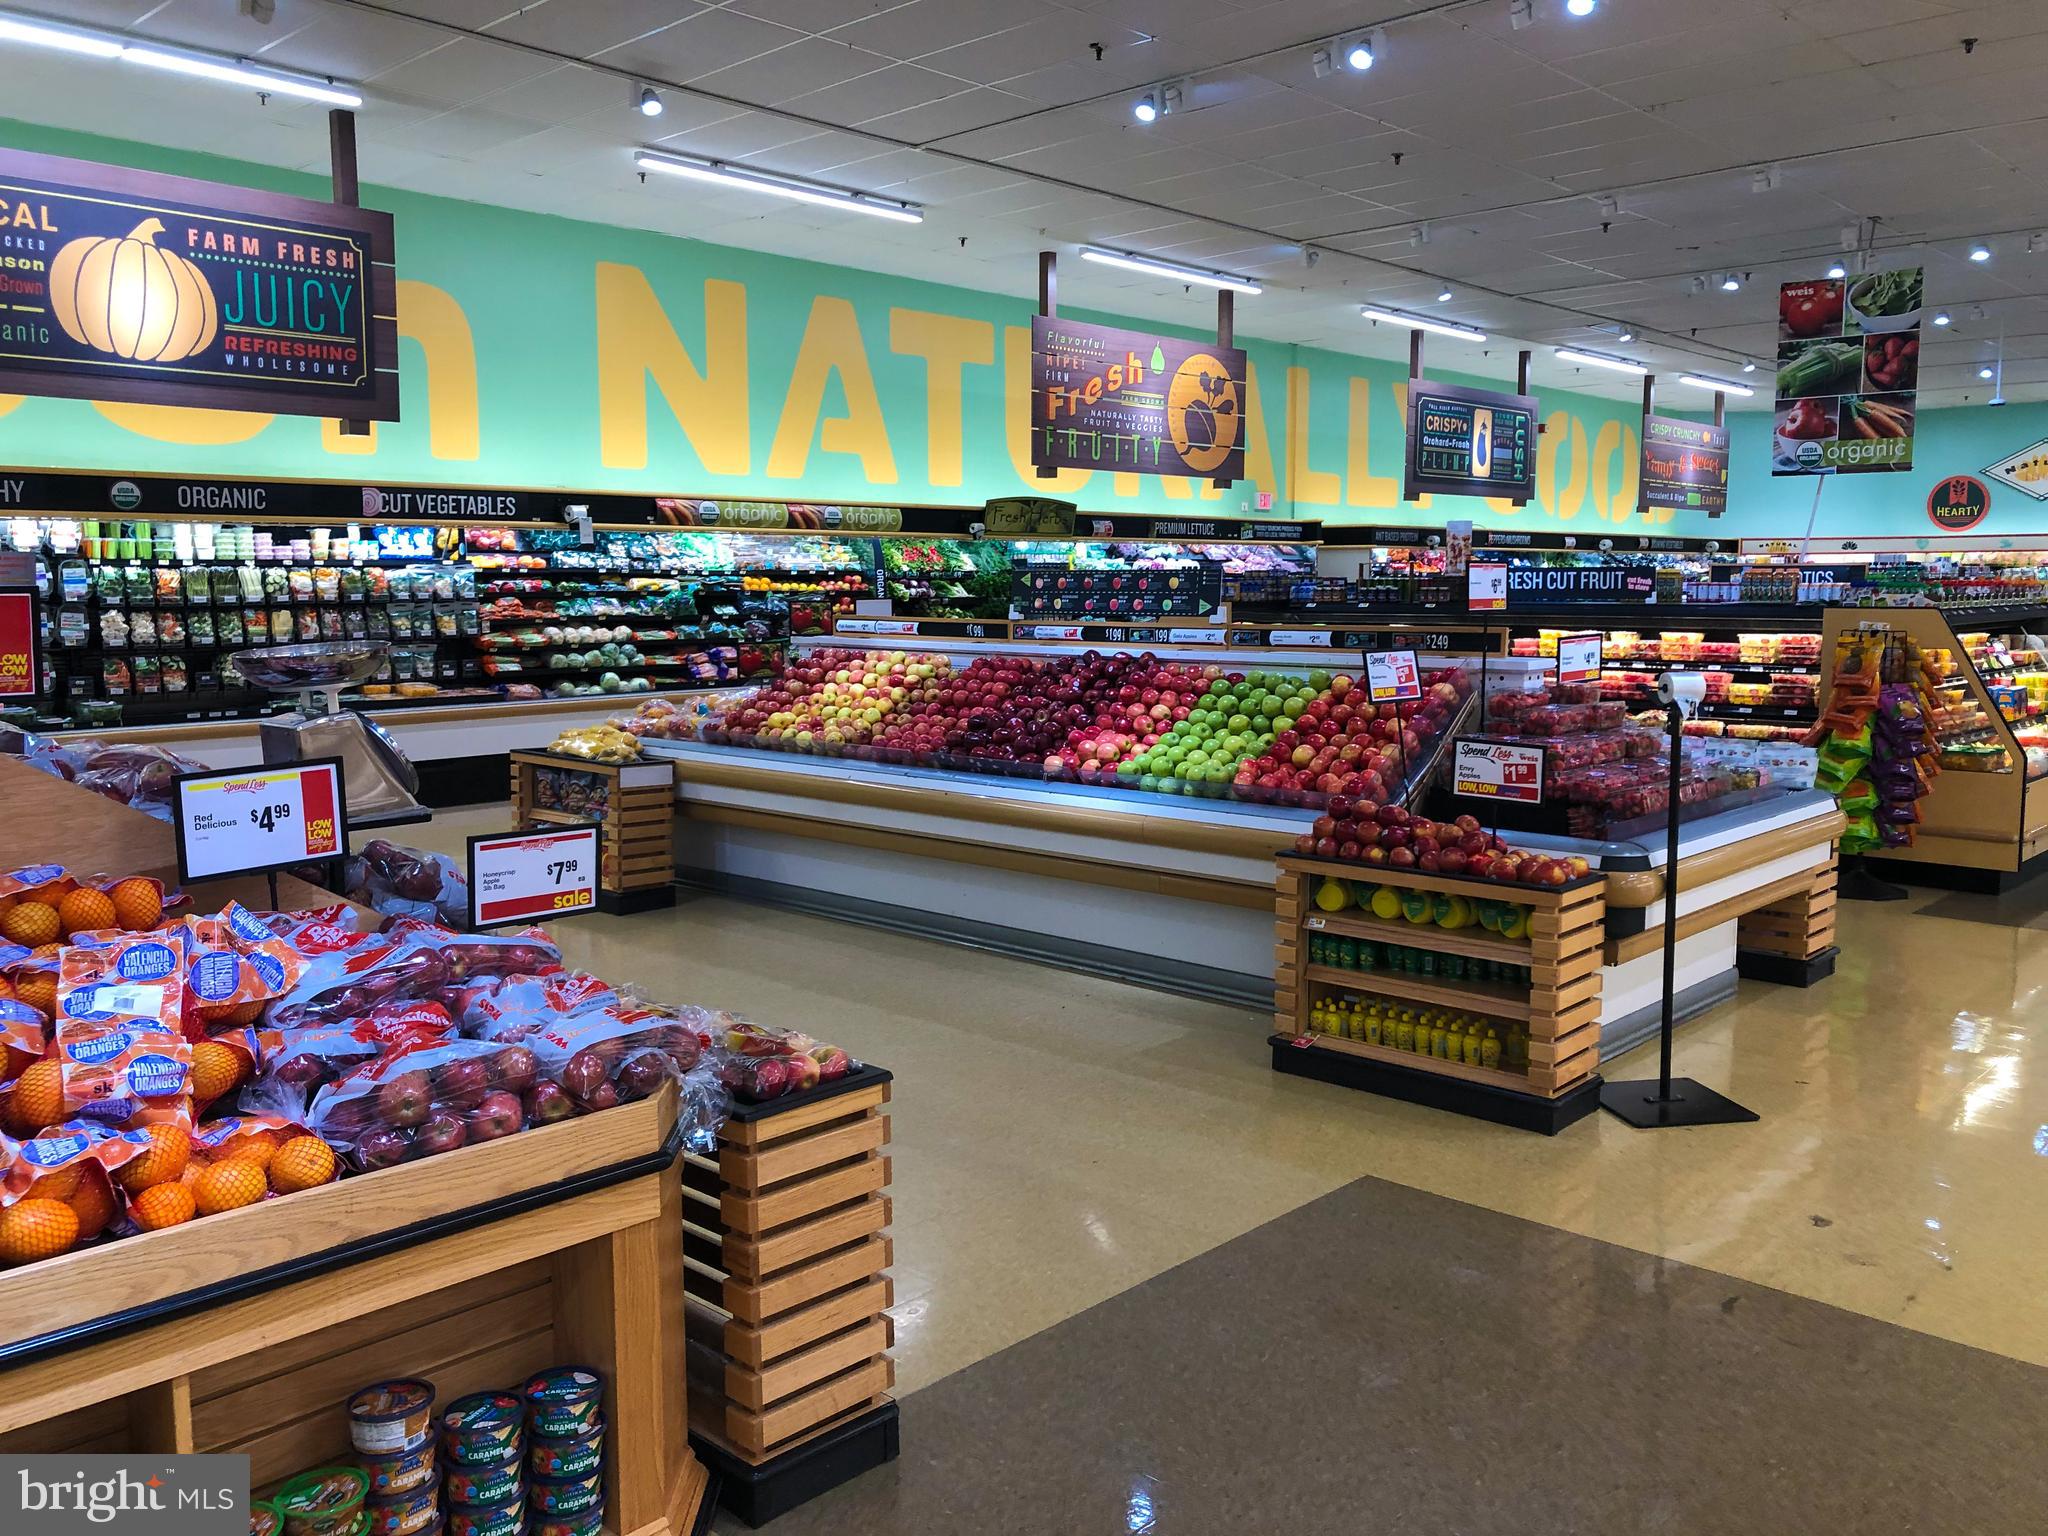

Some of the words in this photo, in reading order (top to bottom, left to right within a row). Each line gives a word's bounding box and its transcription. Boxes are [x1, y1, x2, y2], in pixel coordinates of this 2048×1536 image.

[188, 228, 260, 256] FARM
[278, 242, 354, 270] FRESH
[1786, 286, 1814, 297] weis
[224, 270, 352, 334] JUICY
[1048, 331, 1105, 350] Flavorful
[224, 336, 358, 362] REFRESHING
[226, 354, 348, 376] WHOLESOME
[1046, 370, 1068, 382] FIRM
[1046, 352, 1144, 420] Fresh
[1084, 418, 1110, 428] FRUIT
[1126, 422, 1162, 432] VEGGIES
[1090, 410, 1138, 421] NATURALLY
[1140, 414, 1162, 424] TASTY
[1426, 416, 1462, 434] CRISPY
[1650, 423, 1672, 436] CRISPY
[1673, 427, 1700, 440] CRUNCHY
[1514, 416, 1526, 480] LUSH
[1827, 440, 1906, 464] organic
[178, 486, 266, 510] ORGANIC
[380, 492, 412, 513] CUT
[416, 494, 516, 516] VEGETABLES
[724, 507, 782, 525] organic
[993, 506, 1026, 525] Fresh
[1936, 505, 1980, 516] HEARTY
[846, 512, 897, 528] organic
[1155, 522, 1186, 534] PREMIUM
[1188, 523, 1215, 536] LETTUCE
[1546, 572, 1577, 590] CUT
[1580, 572, 1624, 590] FRUIT
[1800, 571, 1834, 583] TICS
[1426, 634, 1449, 650] $249
[0, 654, 28, 665] OW
[0, 664, 28, 676] OW
[1460, 744, 1491, 758] Spend
[1459, 772, 1480, 780] Apples
[1460, 764, 1475, 772] Envy
[223, 781, 250, 794] Spend
[249, 779, 268, 792] Less
[1458, 782, 1478, 794] LOW,
[1478, 784, 1498, 794] LOW
[194, 814, 213, 822] Red
[194, 818, 238, 831] Delicious
[250, 804, 290, 832] $499
[307, 818, 332, 831] LOW
[308, 828, 332, 840] LOW
[482, 870, 516, 878] Honeycrisp
[547, 860, 578, 884] $799
[554, 889, 590, 909] sale
[232, 908, 270, 938] ORANGES
[124, 950, 170, 966] VALENCIA
[124, 962, 170, 977] ORANGES
[200, 958, 214, 996] ORANGES
[214, 955, 232, 994] VALENCIA
[75, 1040, 126, 1060] ORANGES
[134, 1062, 181, 1076] VALENCIA
[94, 1082, 113, 1094] sk
[134, 1075, 180, 1092] ORANGES
[544, 1422, 579, 1432] CARAMEL
[468, 1446, 506, 1460] CARAMEL
[564, 1456, 595, 1472] CARAMEL
[392, 1470, 428, 1488] CARAME
[480, 1482, 513, 1499] CARAMEL
[558, 1495, 590, 1510] CARAMEL
[402, 1508, 434, 1528] CARAME
